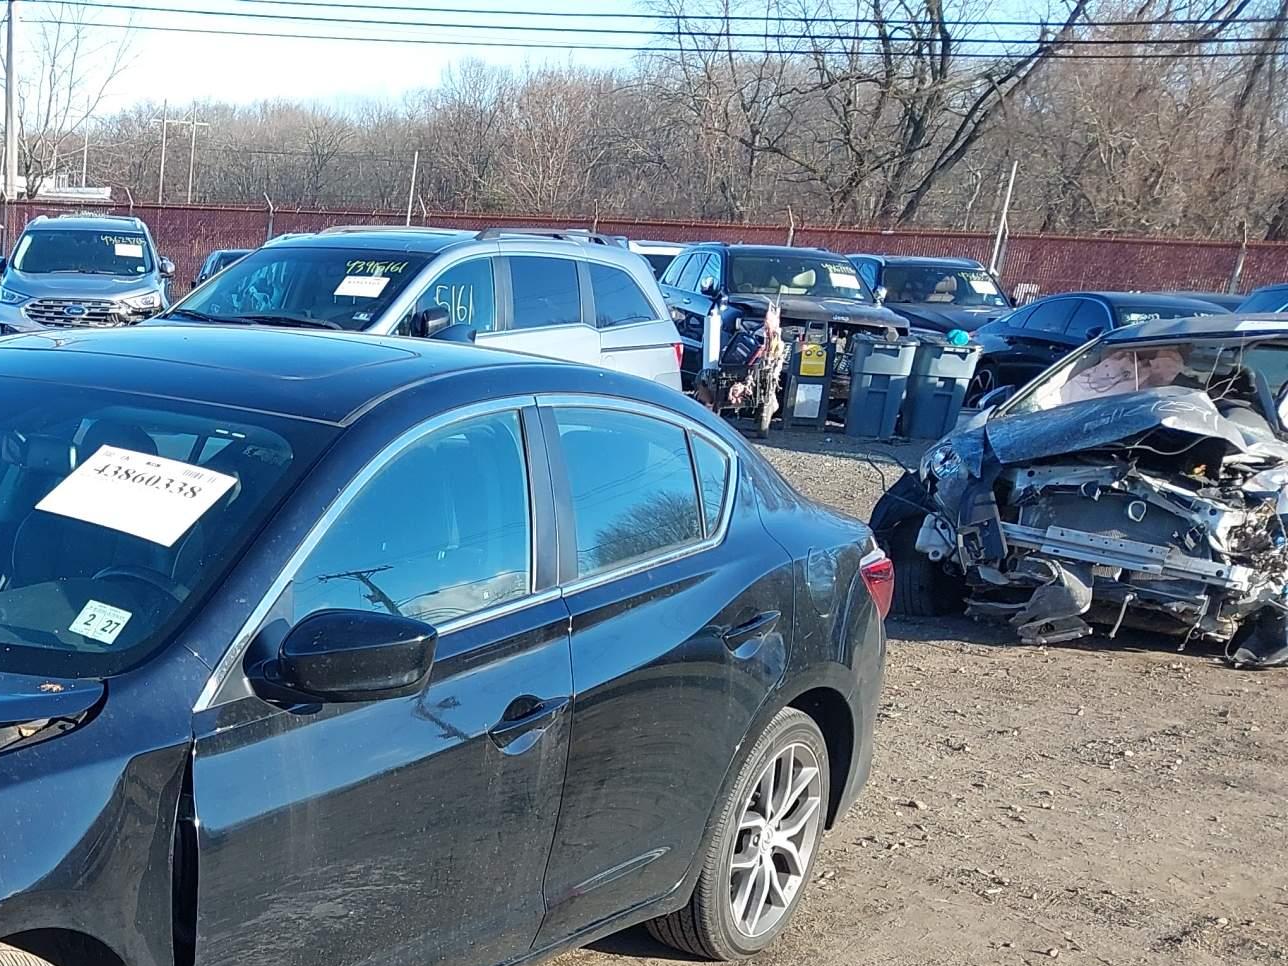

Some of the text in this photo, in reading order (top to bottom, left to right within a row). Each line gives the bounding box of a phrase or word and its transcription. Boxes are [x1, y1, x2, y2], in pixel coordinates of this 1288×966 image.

[434, 284, 473, 325] 5161
[93, 463, 203, 499] 43860338
[83, 613, 121, 634] 2 27
